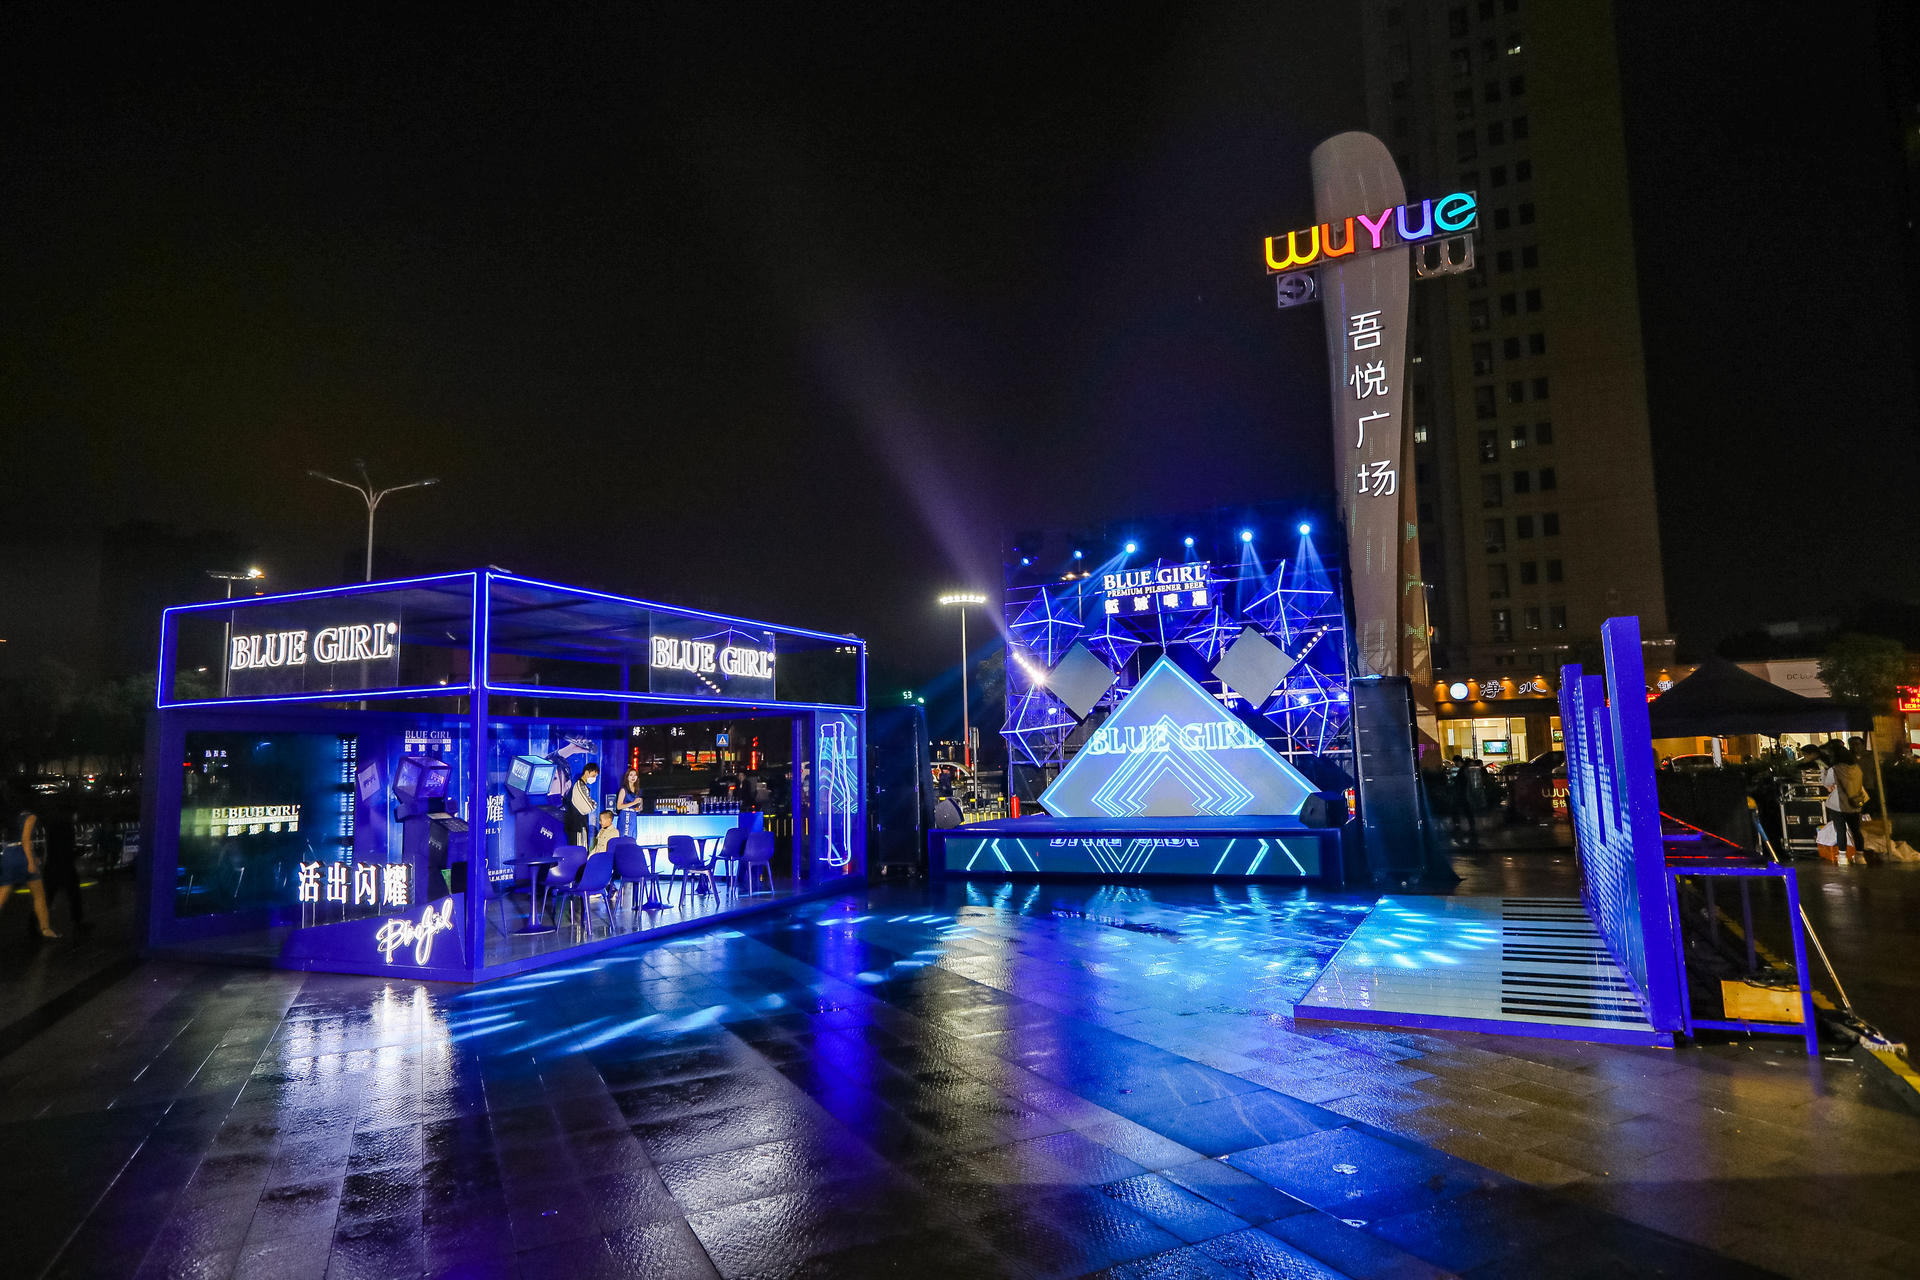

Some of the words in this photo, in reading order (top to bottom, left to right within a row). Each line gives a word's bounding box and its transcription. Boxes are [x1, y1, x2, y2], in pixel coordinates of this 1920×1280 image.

[1347, 310, 1396, 497] 吾悦广场
[1103, 570, 1152, 590] BLUE
[1157, 565, 1206, 584] GIRL
[1107, 587, 1143, 597] PREMIUM
[1144, 584, 1182, 594] PILSENER
[1184, 581, 1205, 590] BEER
[231, 630, 308, 670] BLUE
[313, 622, 394, 663] GIRL
[651, 635, 716, 673] BLUE
[719, 646, 773, 679] GIRL
[405, 730, 428, 739] BLUE
[430, 730, 451, 739] GIRL
[1087, 724, 1170, 756] BLUE
[1179, 720, 1265, 751] GIRL
[298, 861, 409, 906] 活出闪耀
